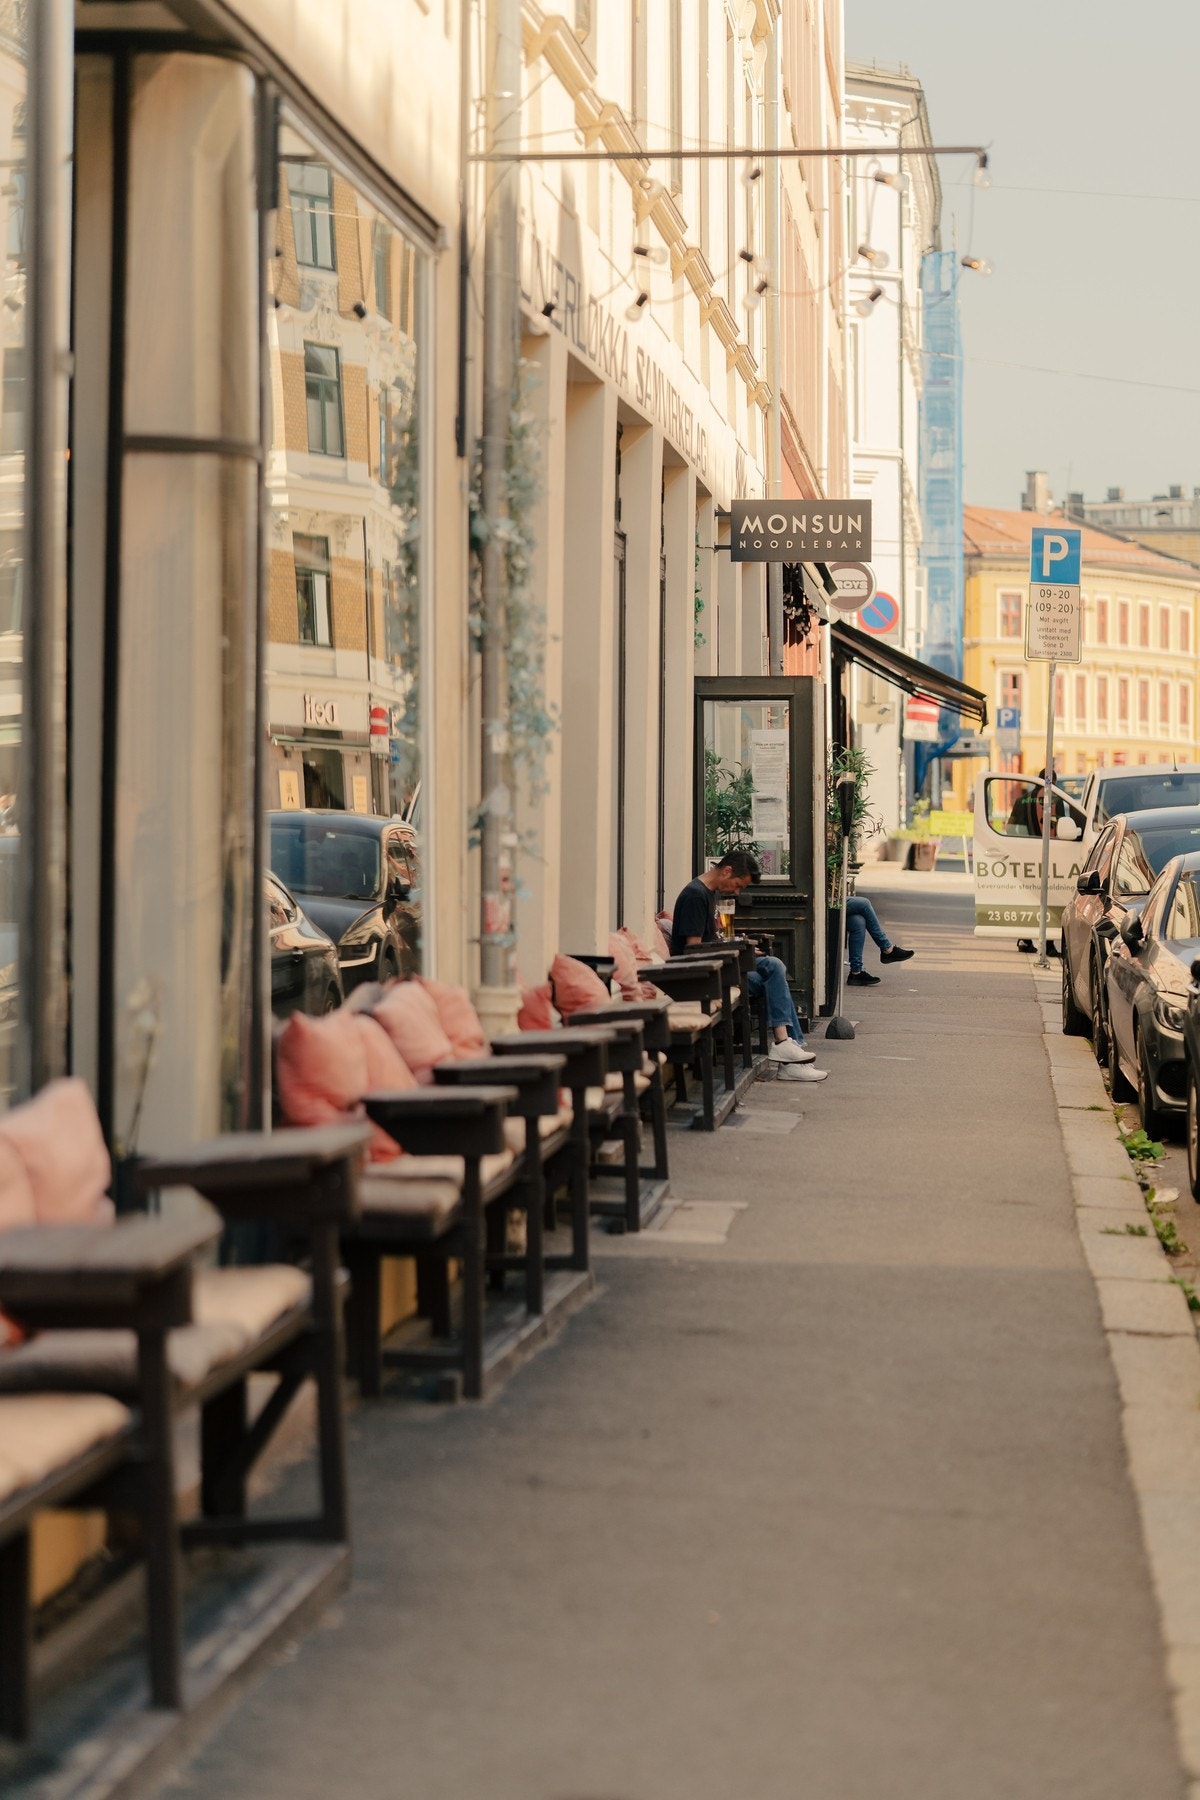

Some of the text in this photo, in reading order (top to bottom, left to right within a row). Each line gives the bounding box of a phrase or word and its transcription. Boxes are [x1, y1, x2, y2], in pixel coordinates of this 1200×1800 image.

[740, 514, 862, 534] MONSUN
[739, 540, 862, 549] NOODLEBAR
[1042, 534, 1069, 577] P
[836, 580, 868, 589] ROYS
[1052, 617, 1069, 625] avgift
[1038, 634, 1069, 642] beboerkort
[1000, 709, 1013, 727] P
[1018, 883, 1076, 892] storhuoldning
[987, 910, 1001, 921] 23
[1003, 910, 1018, 922] 68
[1020, 911, 1034, 922] 77
